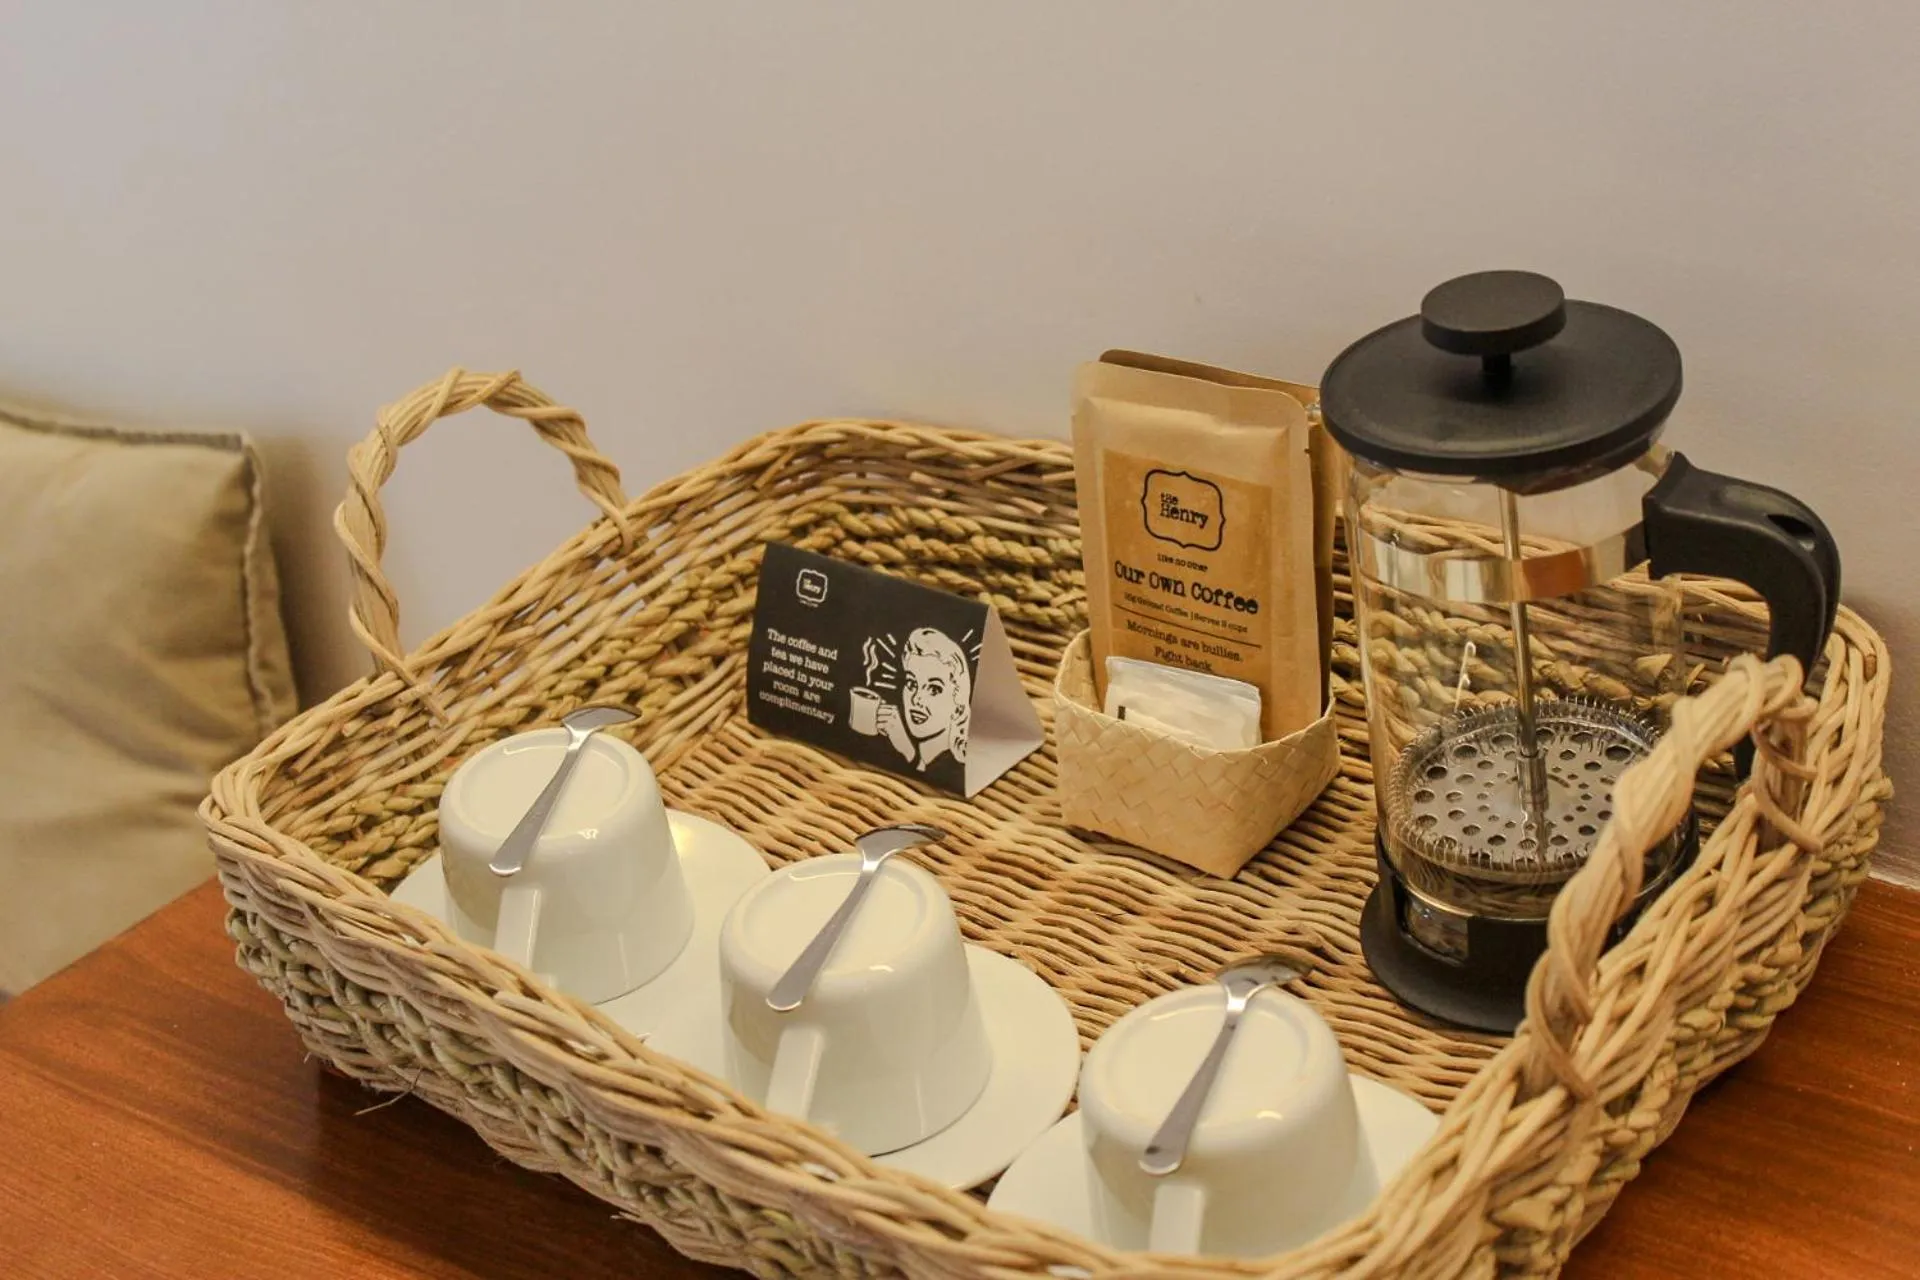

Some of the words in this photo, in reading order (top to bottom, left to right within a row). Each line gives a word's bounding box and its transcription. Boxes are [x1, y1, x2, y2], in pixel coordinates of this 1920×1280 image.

[1160, 503, 1209, 529] Henry
[1114, 560, 1145, 584] Our
[1149, 571, 1187, 597] Own
[1191, 582, 1259, 615] Coffee
[767, 627, 786, 644] The
[787, 636, 817, 654] coffee
[818, 646, 838, 660] and
[1127, 619, 1178, 644] Mornings
[1180, 637, 1200, 650] are
[771, 646, 787, 661] tea
[789, 653, 803, 666] we
[804, 656, 829, 674] have
[762, 661, 795, 680] placed
[797, 671, 807, 683] in
[807, 676, 835, 692] your
[773, 680, 800, 697] room
[803, 690, 821, 704] are
[759, 691, 835, 724] complimentary
